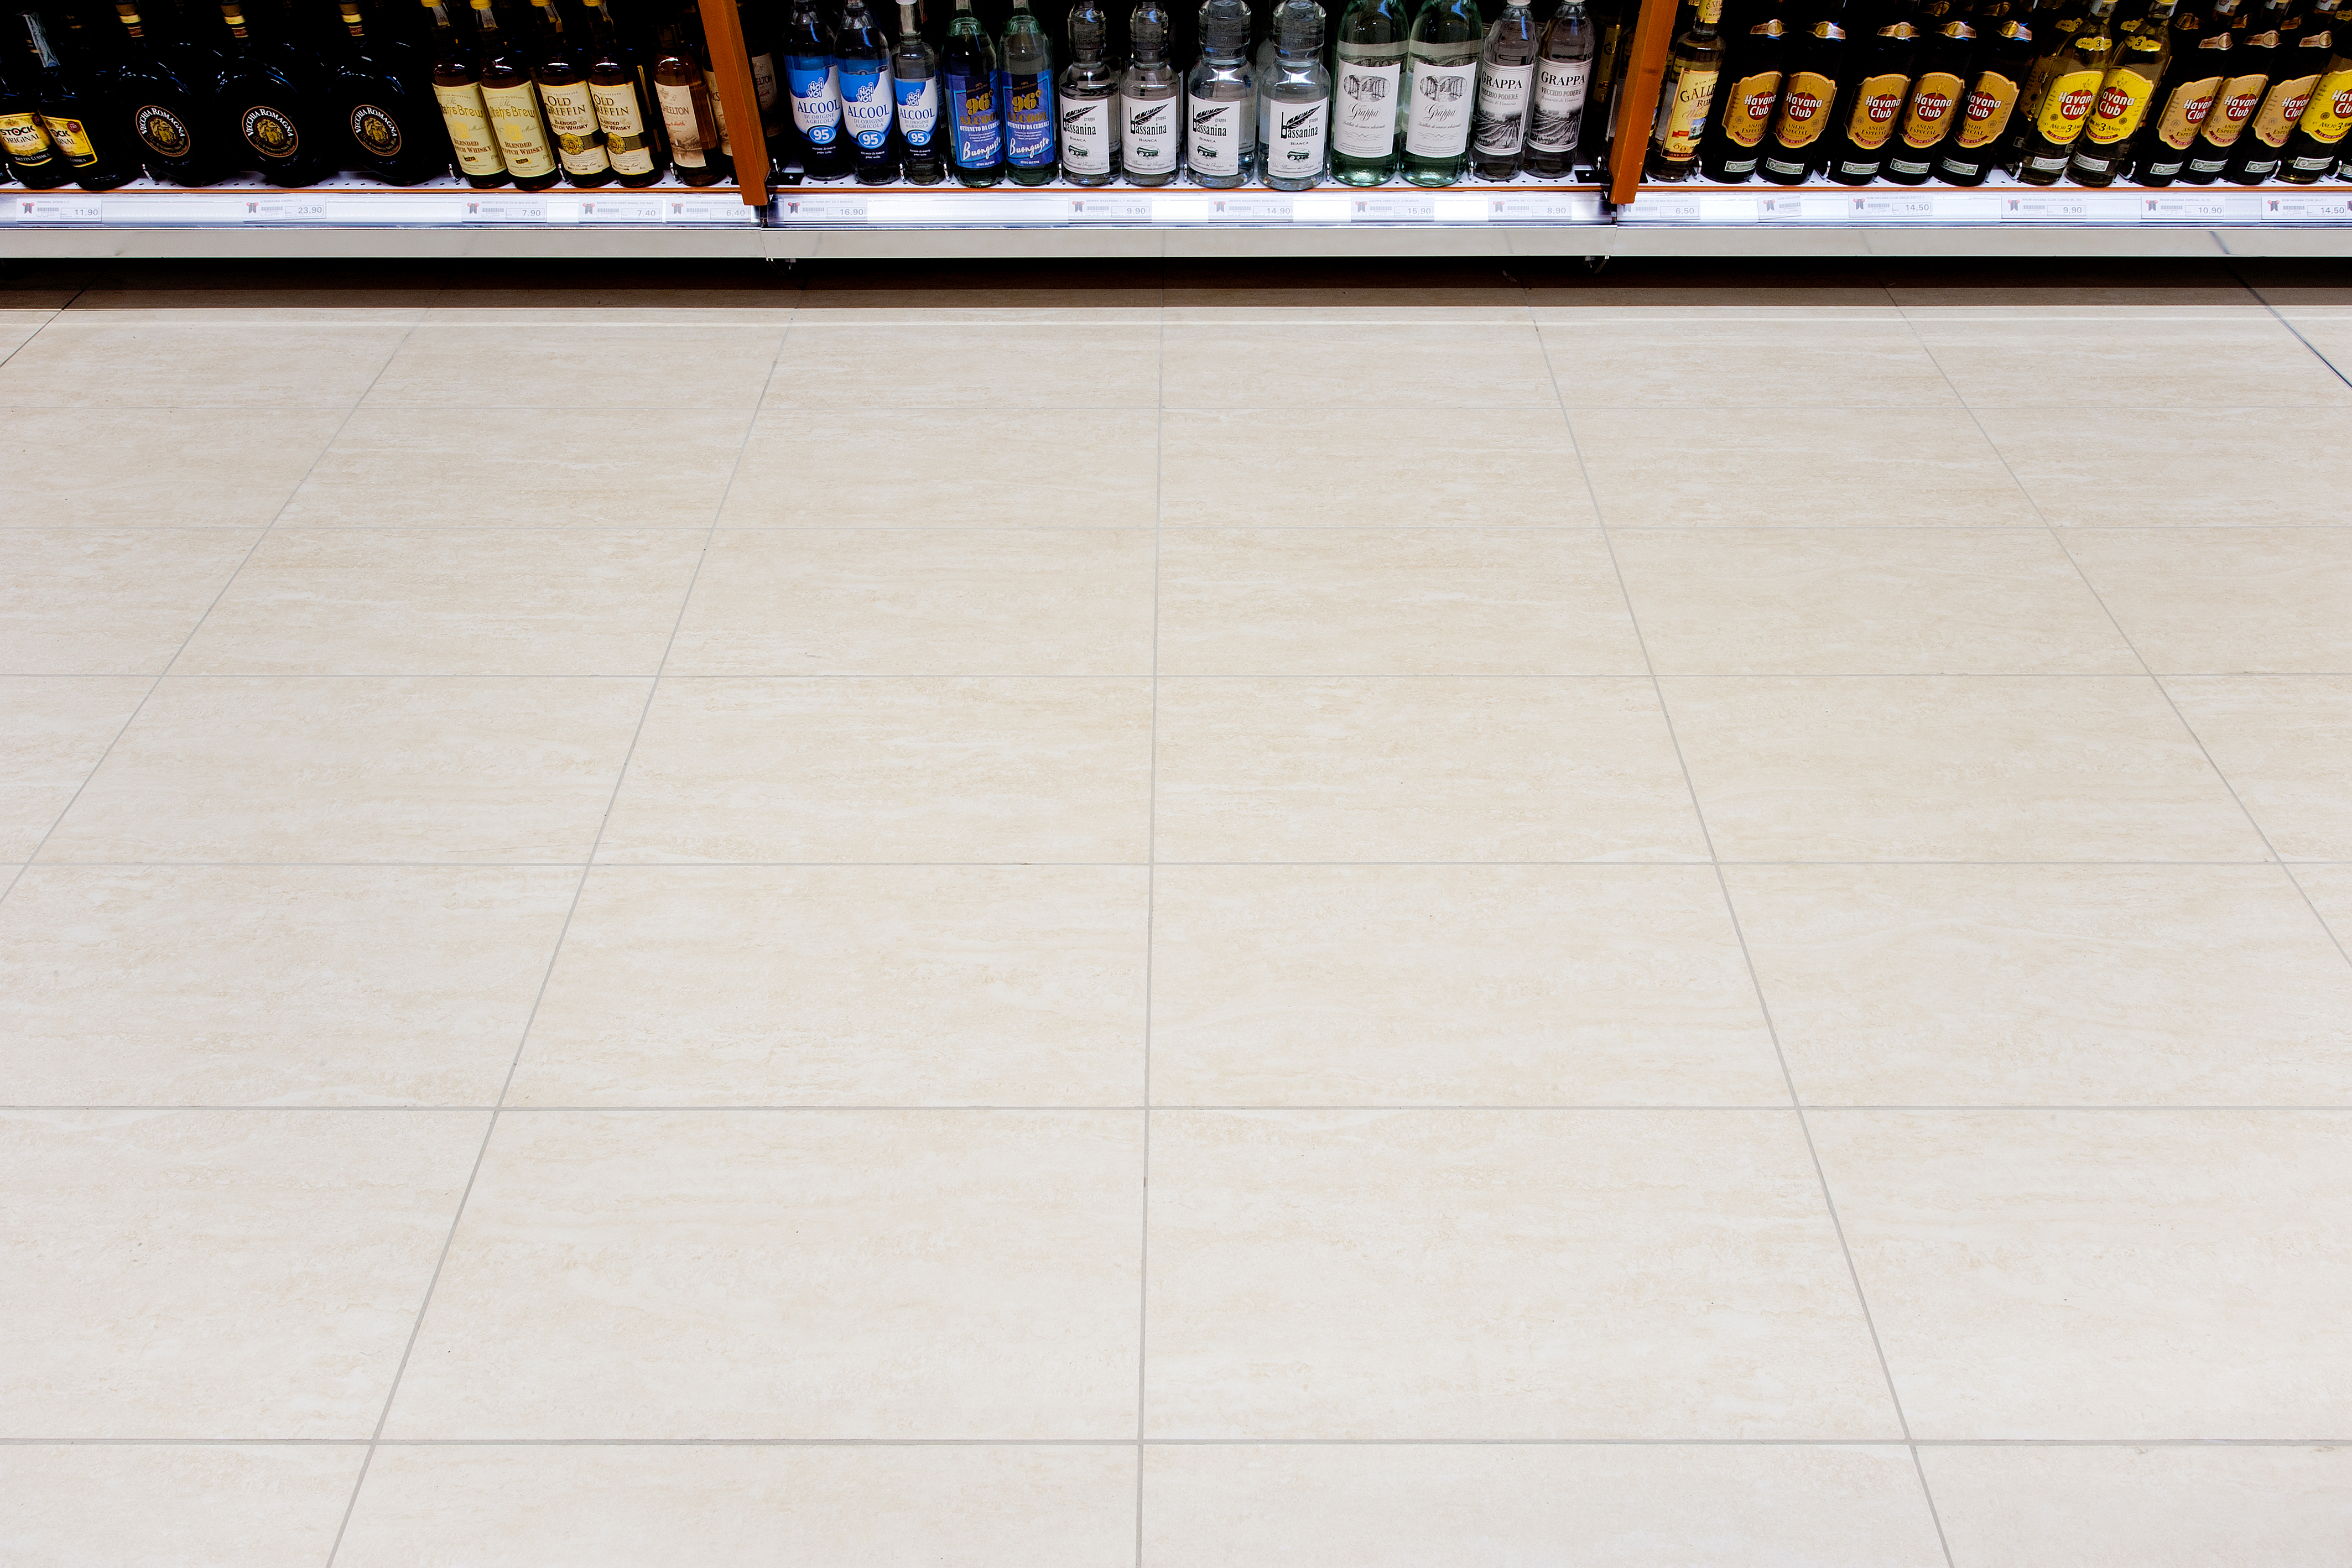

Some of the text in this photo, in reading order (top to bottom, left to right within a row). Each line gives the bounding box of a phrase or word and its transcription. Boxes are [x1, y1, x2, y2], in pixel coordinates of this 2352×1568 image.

[1482, 71, 1522, 89] GRAPPA
[1541, 71, 1585, 86] GRAPPA
[1482, 87, 1497, 98] VECCHIO
[1541, 87, 1581, 97] VECCHIO PODERE
[2100, 87, 2136, 106] avana
[547, 95, 571, 107] OLD
[594, 93, 614, 107] OLD
[966, 88, 993, 115] 96°
[1012, 88, 1042, 113] 96°
[1744, 95, 1776, 105] Havana
[1786, 92, 1823, 107] Havana
[1865, 96, 1901, 107] Havana
[1914, 93, 1952, 107] Havana
[457, 105, 483, 118] Brew
[511, 106, 535, 118] Brew
[545, 103, 586, 117] GRIFFIN
[798, 99, 840, 114] ALCOOL
[848, 104, 889, 118] ALCOOL
[1347, 103, 1381, 121] Grappa
[1423, 103, 1458, 122] Grappa
[1750, 106, 1769, 116] Club
[1789, 106, 1812, 118] Club
[1919, 106, 1941, 117] Club
[1968, 105, 1989, 118] Club
[2063, 105, 2086, 115] Club
[2099, 101, 2121, 116] Club
[2228, 107, 2249, 117] Club
[900, 108, 935, 120] ALCOOL
[1007, 111, 1049, 123] ALCOOL
[1062, 103, 1096, 135] bassanina
[1870, 108, 1892, 118] Club
[2187, 110, 2207, 120] Club
[139, 107, 185, 137] VECCHIA ROMAGNA
[246, 108, 294, 137] VECCHIA ROMAGNA
[354, 107, 397, 137] VECCHIA ROMAGNA
[1007, 121, 1026, 130] OTTENUTO
[1034, 119, 1049, 129] CEREALI
[1130, 107, 1167, 134] bassanina
[1193, 105, 1227, 136] bassanina
[1281, 112, 1318, 138] bassanina
[2335, 122, 2343, 131] 3
[1, 125, 36, 136] STOCK
[50, 129, 70, 137] OCK
[1782, 126, 1807, 135] ESPECIAL
[2099, 123, 2106, 131] 3
[3, 133, 40, 143] ORIGINAL
[813, 129, 830, 140] 95
[862, 134, 879, 145] 95
[911, 133, 925, 143] 95
[453, 138, 479, 147] BLENDED
[1010, 137, 1049, 158] Buongusto
[520, 146, 543, 155] WHISKY
